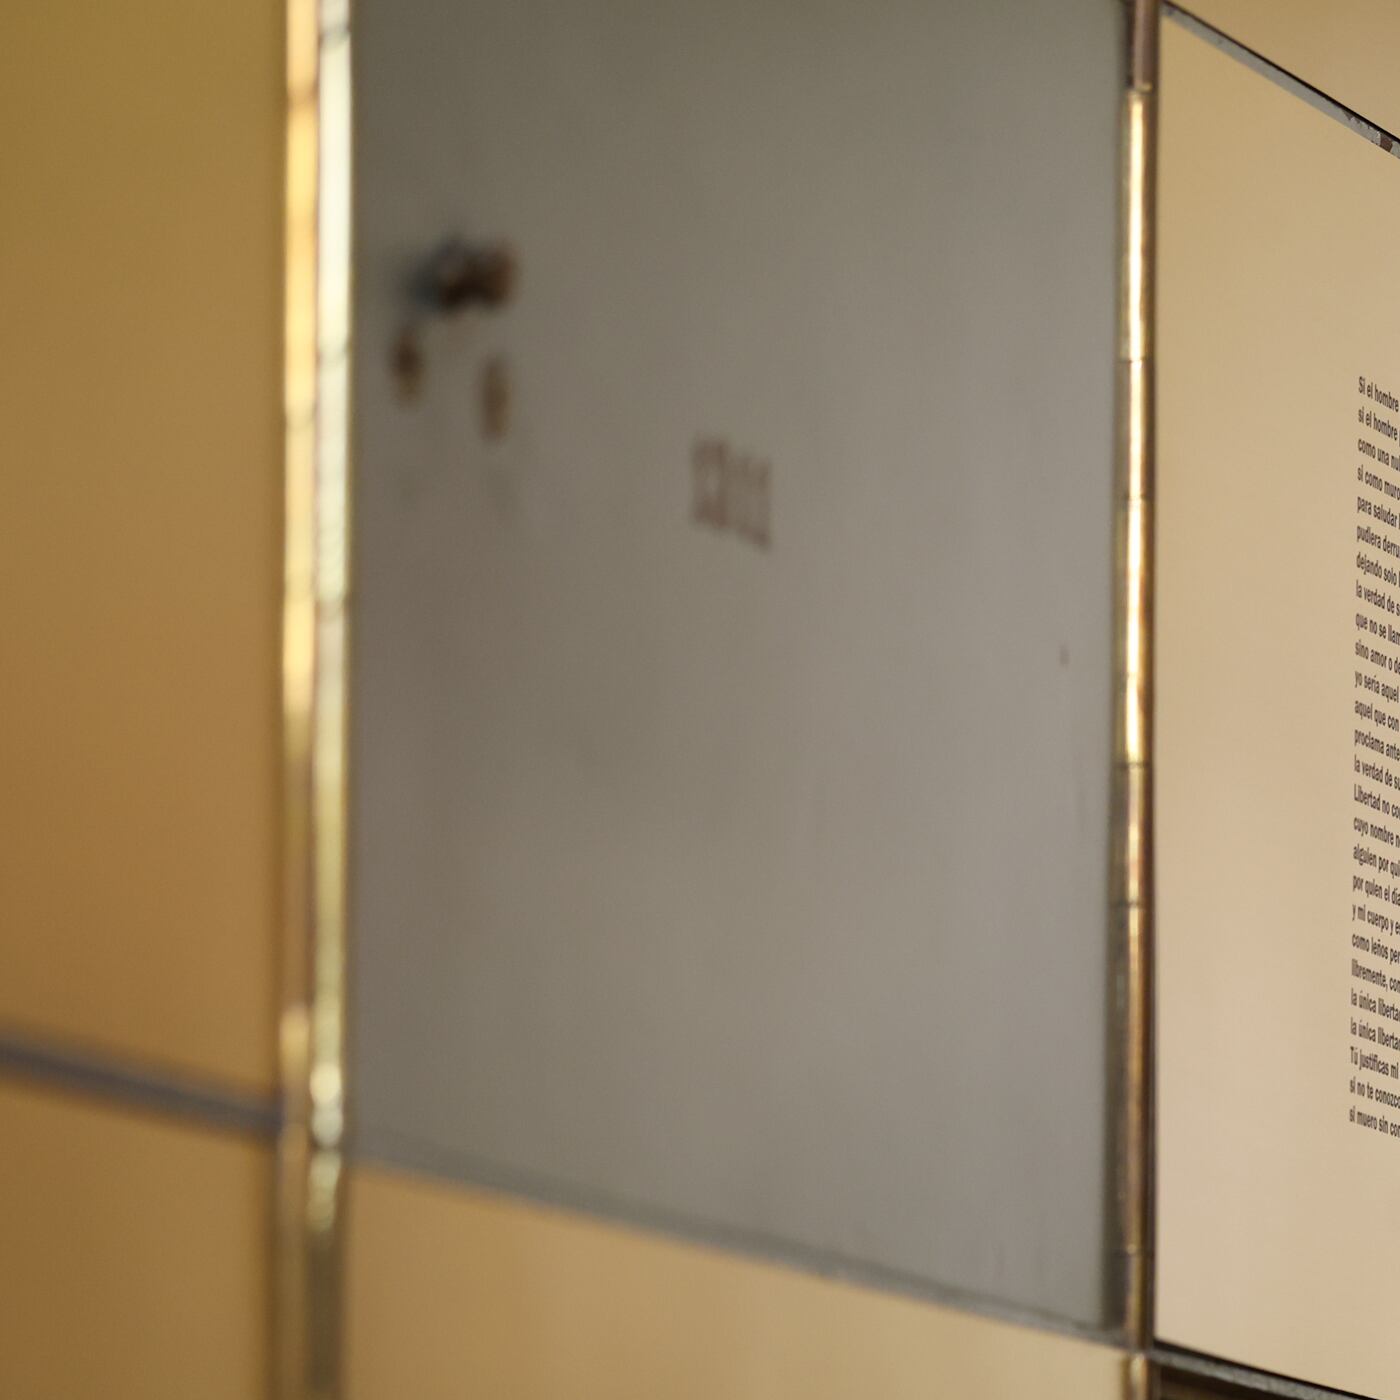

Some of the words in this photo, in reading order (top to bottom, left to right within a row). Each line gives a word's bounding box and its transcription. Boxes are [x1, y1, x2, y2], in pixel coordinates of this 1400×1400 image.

[1358, 376, 1365, 394] Si
[1366, 382, 1373, 399] el
[1374, 384, 1398, 412] hombre
[1358, 406, 1364, 423] si
[1365, 410, 1372, 427] el
[1373, 412, 1397, 440] hombre
[1357, 438, 1376, 458] como
[1377, 448, 1389, 466] una
[1357, 464, 1363, 481] si
[1364, 471, 1382, 491] como
[1357, 496, 1371, 515] para
[1373, 504, 1397, 527] saludar
[1356, 525, 1381, 548] pudiera
[1356, 552, 1382, 578] dejando
[1383, 567, 1397, 586] solo
[1355, 579, 1362, 598] la
[1363, 587, 1385, 609] verdad
[1386, 595, 1394, 613] de
[1355, 613, 1367, 630] que
[1369, 619, 1377, 634] no
[1378, 623, 1386, 639] se
[1355, 639, 1369, 659] sino
[1370, 649, 1386, 668] amor
[1355, 670, 1362, 687] yo
[1364, 675, 1380, 694] sería
[1381, 681, 1399, 702] aquel
[1354, 700, 1372, 719] aquel
[1374, 709, 1386, 726] que
[1387, 715, 1399, 732] con
[1354, 729, 1384, 754] proclama
[1385, 743, 1400, 761] ante
[1354, 754, 1360, 772] la
[1362, 761, 1383, 782] verdad
[1384, 768, 1392, 788] de
[1393, 775, 1400, 791] su
[1353, 817, 1368, 836] cuyo
[1370, 824, 1394, 845] nombre
[1351, 933, 1369, 951] como
[1371, 937, 1388, 959] leños
[1350, 987, 1357, 1006] la
[1358, 991, 1376, 1013] única
[1350, 1016, 1356, 1035] la
[1358, 1020, 1376, 1042] única
[1350, 1046, 1358, 1065] Tú
[1359, 1049, 1389, 1075] justificas
[1390, 1062, 1398, 1079] mi
[1349, 1076, 1355, 1093] si
[1357, 1081, 1365, 1097] no
[1366, 1082, 1373, 1099] te
[1349, 1106, 1355, 1122] si
[1356, 1111, 1377, 1129] muero
[1378, 1115, 1388, 1133] sin
